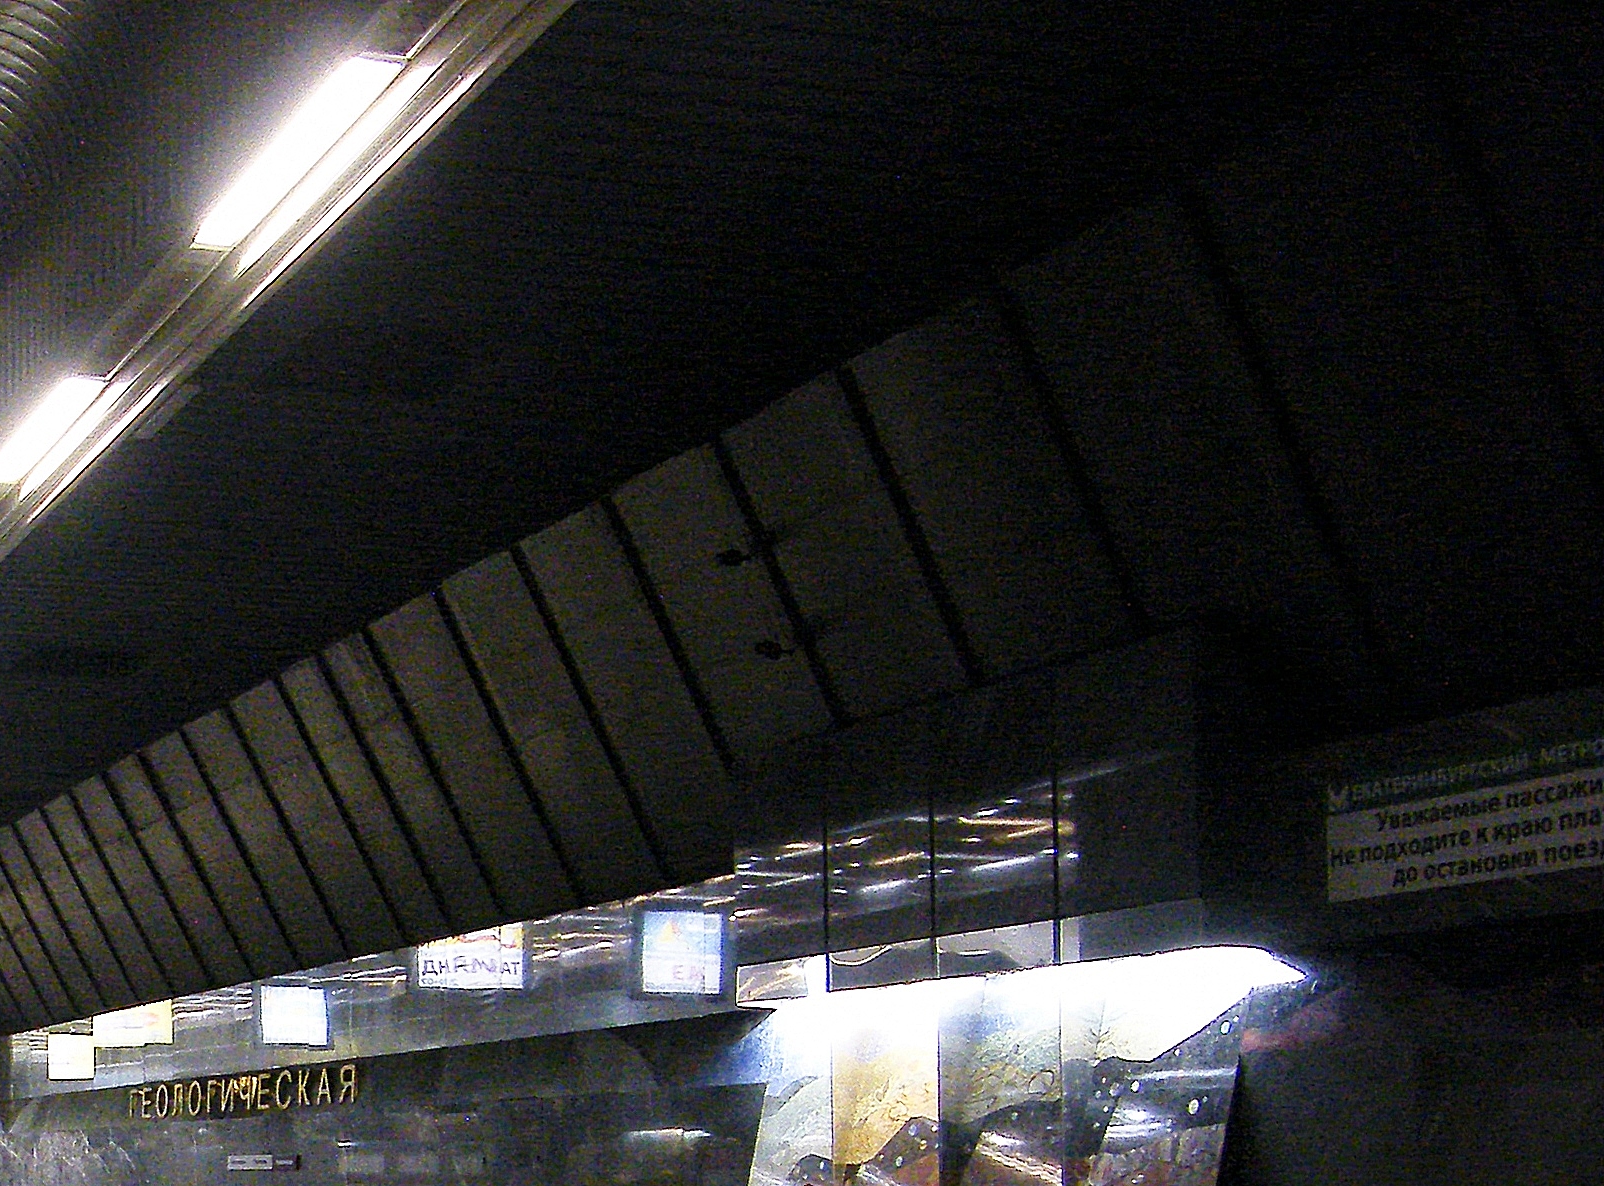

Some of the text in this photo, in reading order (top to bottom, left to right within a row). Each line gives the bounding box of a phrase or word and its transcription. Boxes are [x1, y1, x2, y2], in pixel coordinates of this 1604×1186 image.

[1375, 795, 1500, 832] Уважаемые
[1359, 828, 1470, 863] подходите
[1476, 827, 1488, 843] к
[1493, 815, 1552, 843] краю
[1392, 840, 1604, 887] до остановки поез
[129, 1064, 357, 1119] ГЕОЛОГИЧЕСКАЯ
